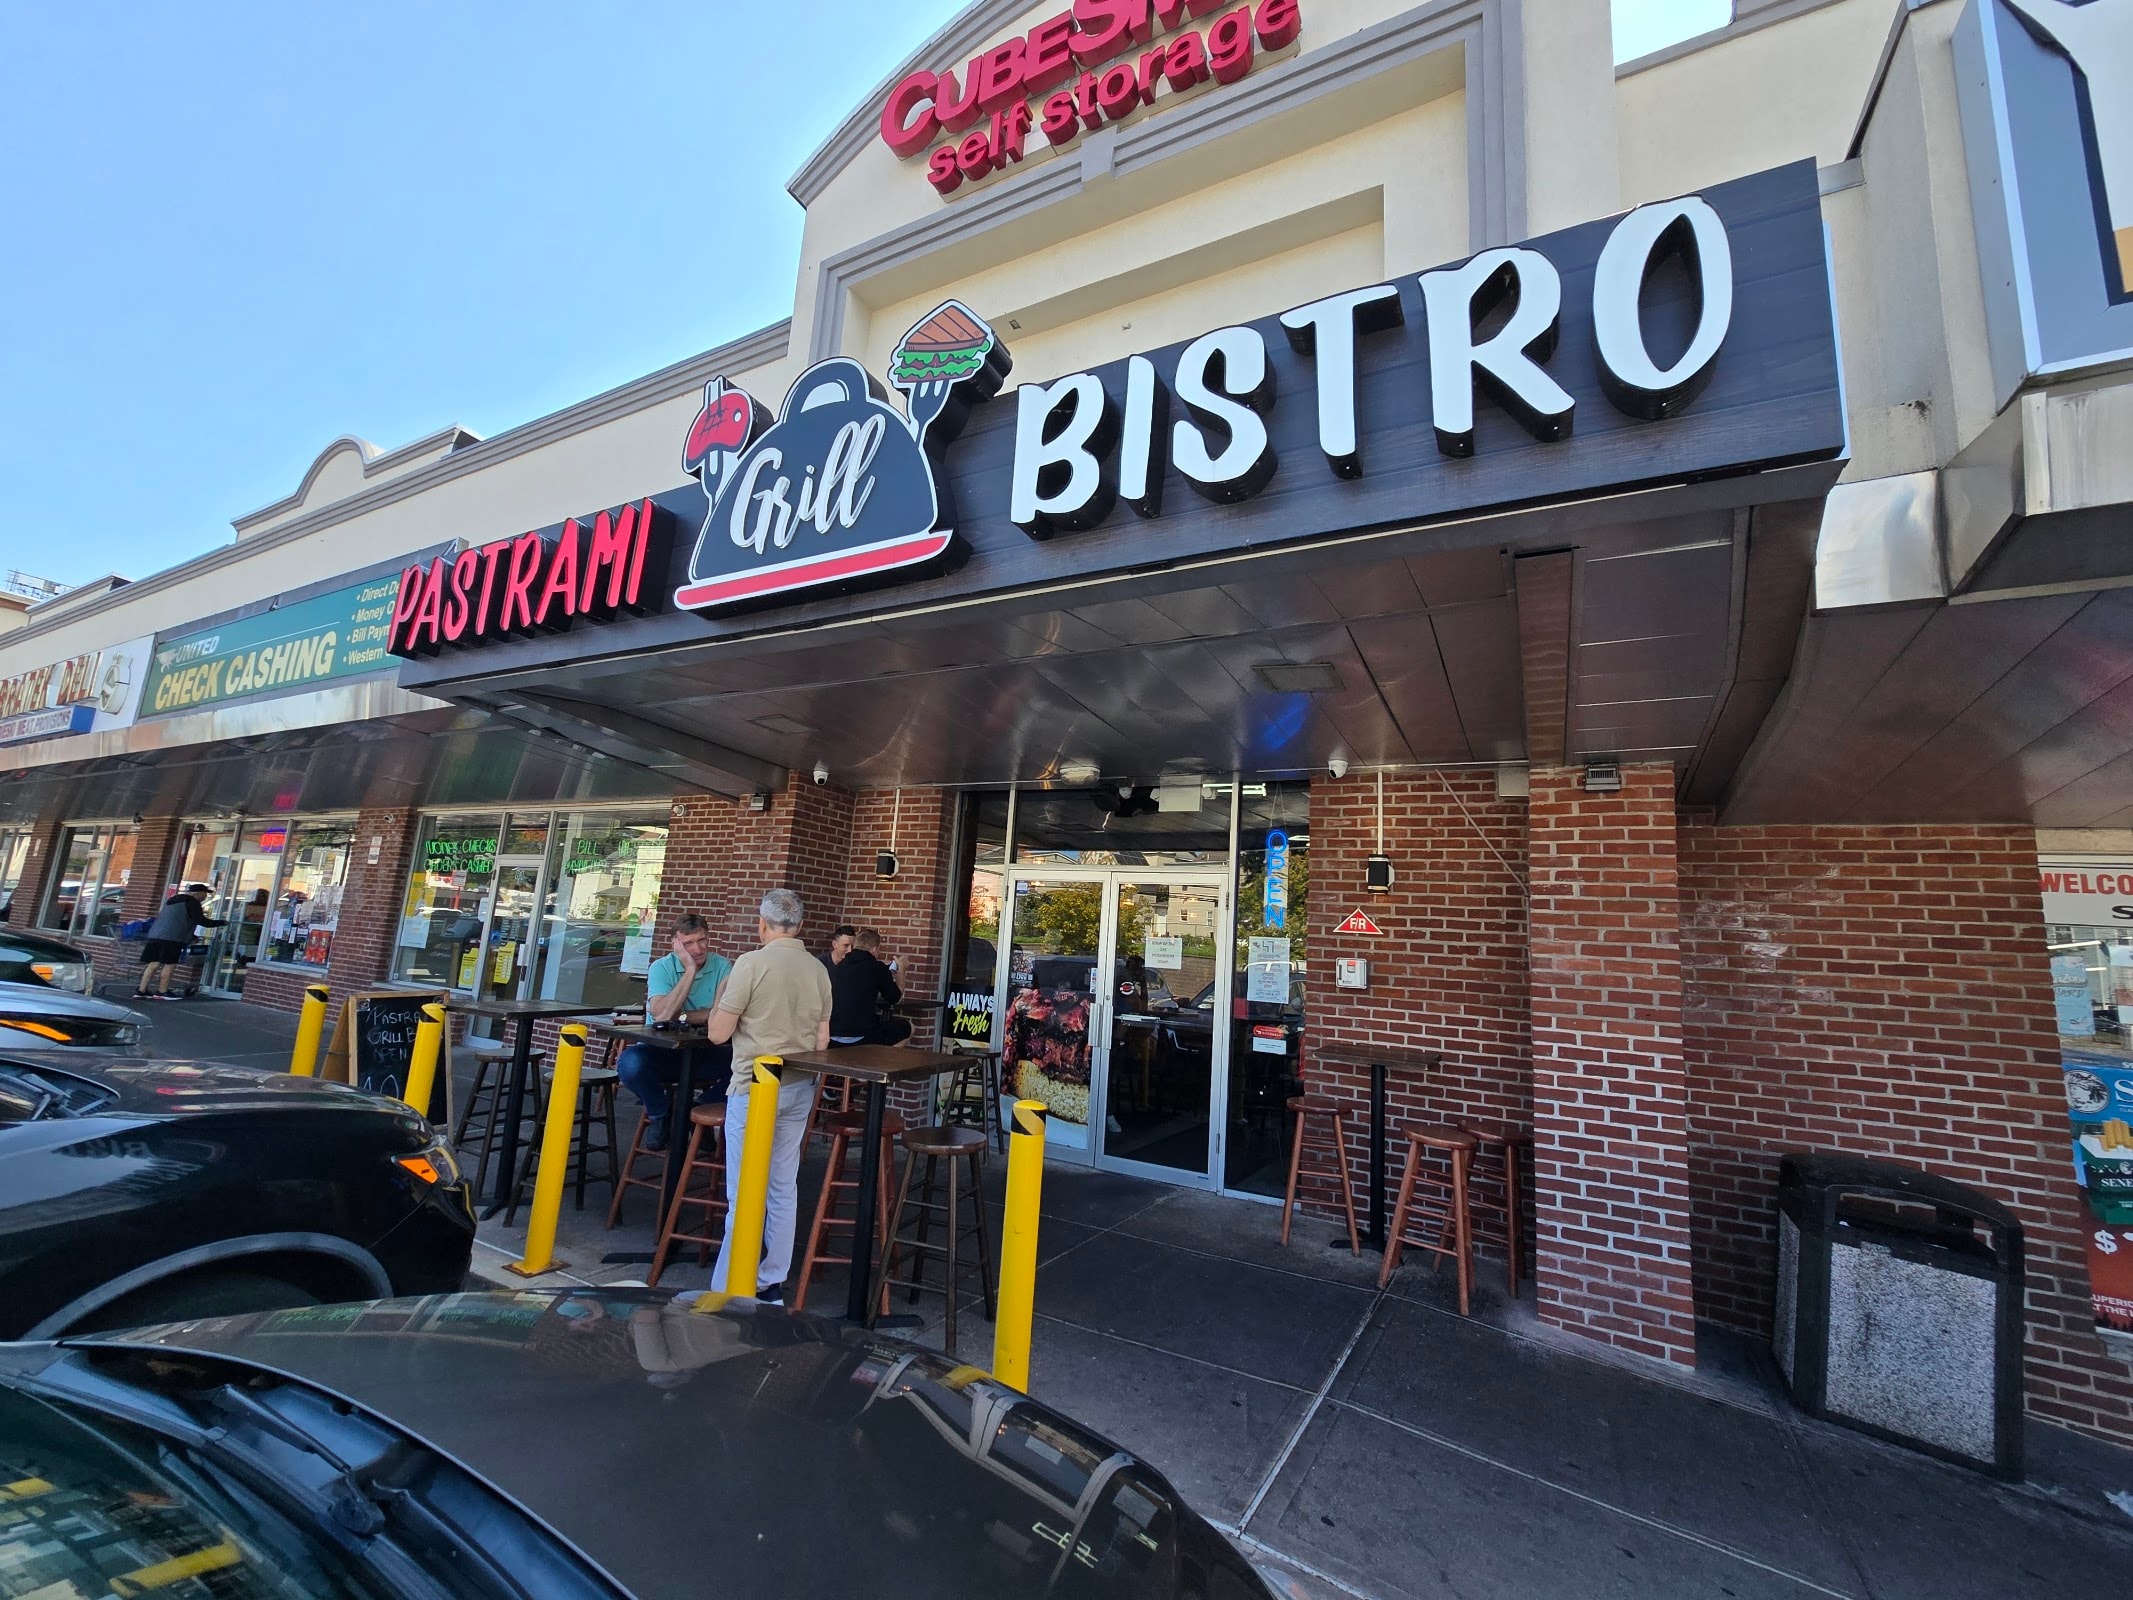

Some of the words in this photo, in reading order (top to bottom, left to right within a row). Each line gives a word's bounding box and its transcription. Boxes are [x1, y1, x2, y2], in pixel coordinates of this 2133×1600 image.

[927, 100, 1033, 188] self
[1040, 0, 1299, 142] storage
[386, 497, 658, 655] PASTRAMI
[729, 413, 886, 555] Grill
[1010, 193, 1734, 532] BISTRO
[361, 583, 389, 602] Direct
[356, 605, 385, 623] Money
[351, 627, 368, 644] Bill
[176, 635, 220, 663] UNITED
[348, 647, 384, 666] Western
[57, 651, 103, 705] DELI
[154, 659, 226, 711] CHECK
[225, 630, 337, 695] CASHING
[1266, 829, 1288, 929] OPEN
[1349, 917, 1367, 930] F/R
[948, 991, 995, 1012] ALWAYS
[953, 1003, 990, 1035] Fresh
[367, 1027, 404, 1045] GRILL
